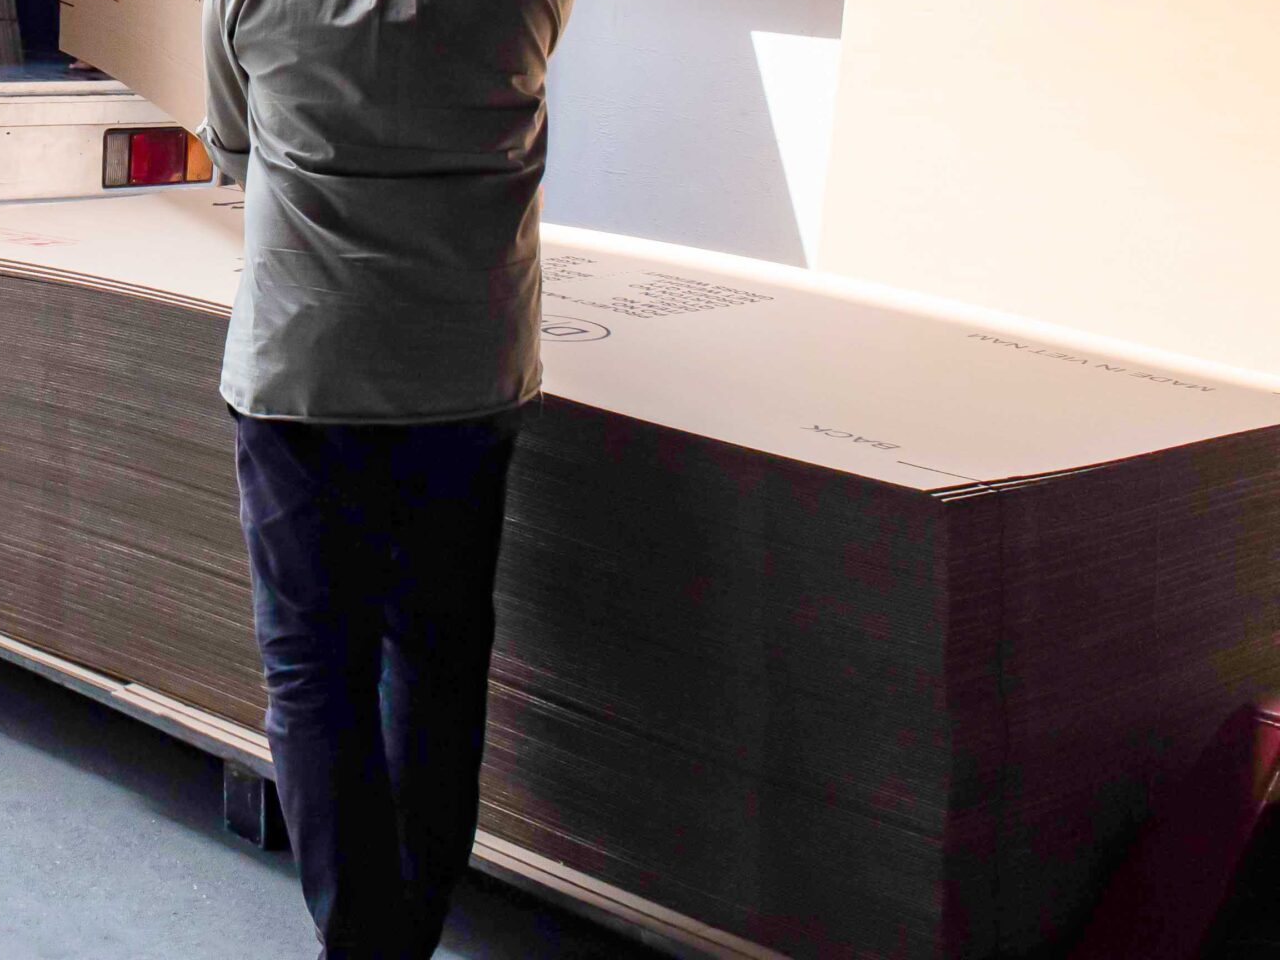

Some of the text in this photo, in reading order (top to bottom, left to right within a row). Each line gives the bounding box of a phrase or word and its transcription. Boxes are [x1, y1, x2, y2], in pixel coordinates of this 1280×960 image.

[968, 334, 1216, 392] MADE IN VIET NAM
[801, 424, 901, 450] BACK
